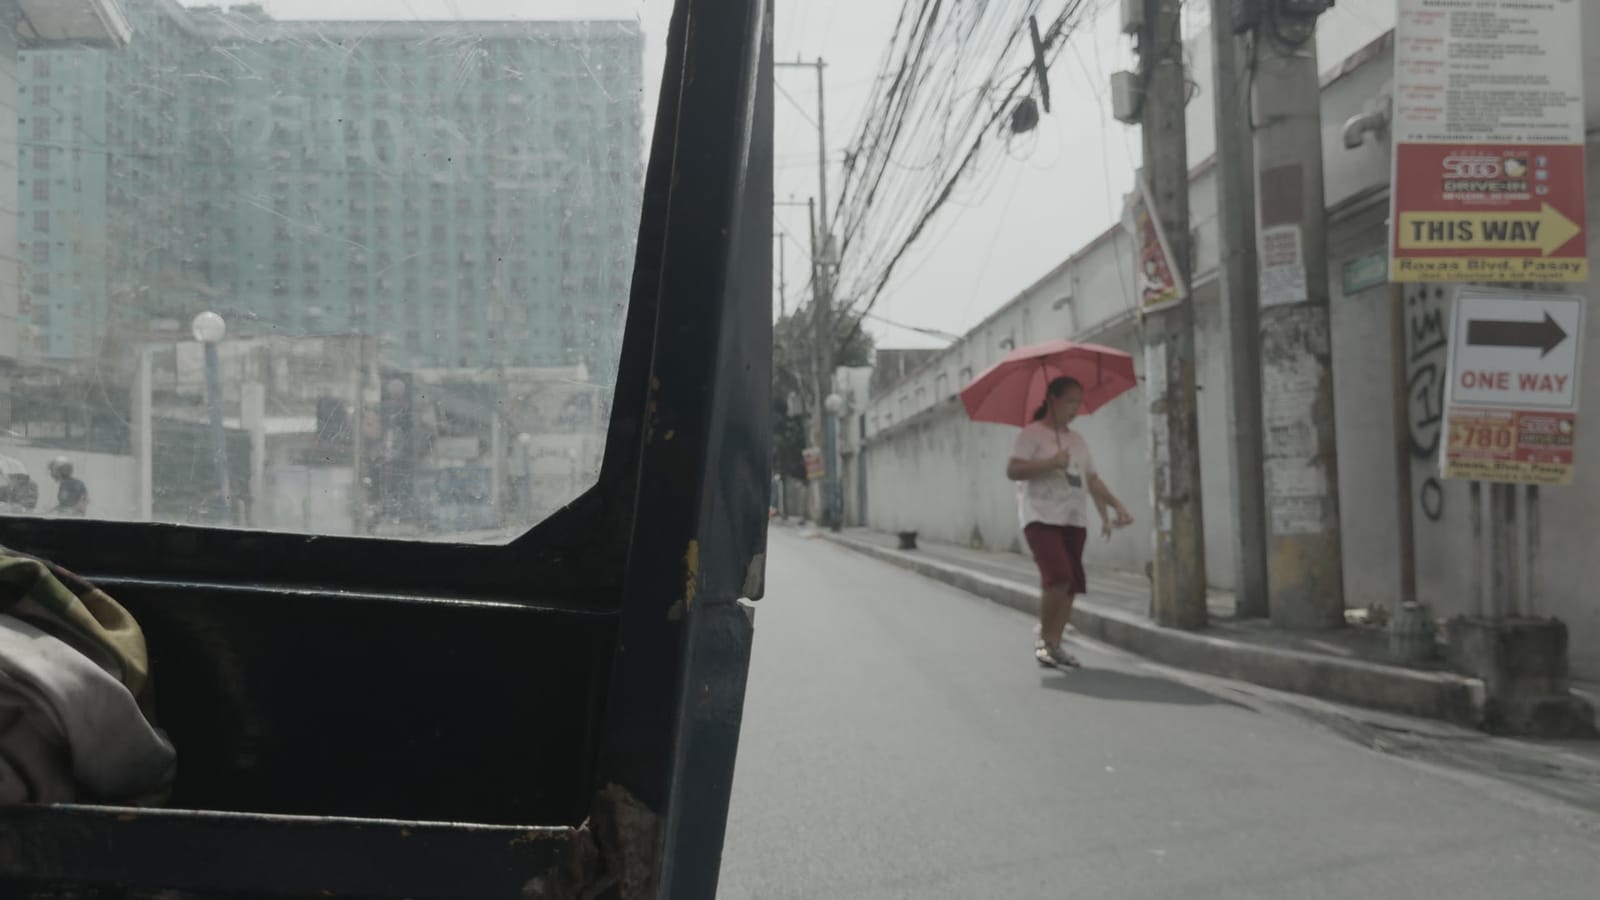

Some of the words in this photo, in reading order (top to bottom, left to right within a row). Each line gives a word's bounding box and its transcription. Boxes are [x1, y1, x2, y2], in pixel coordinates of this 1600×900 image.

[1410, 221, 1473, 242] THIS
[1481, 221, 1541, 242] WAY
[1400, 259, 1459, 271] Roxas
[1522, 259, 1581, 273] Pasay
[1460, 370, 1511, 390] ONE
[1518, 373, 1568, 393] WAY
